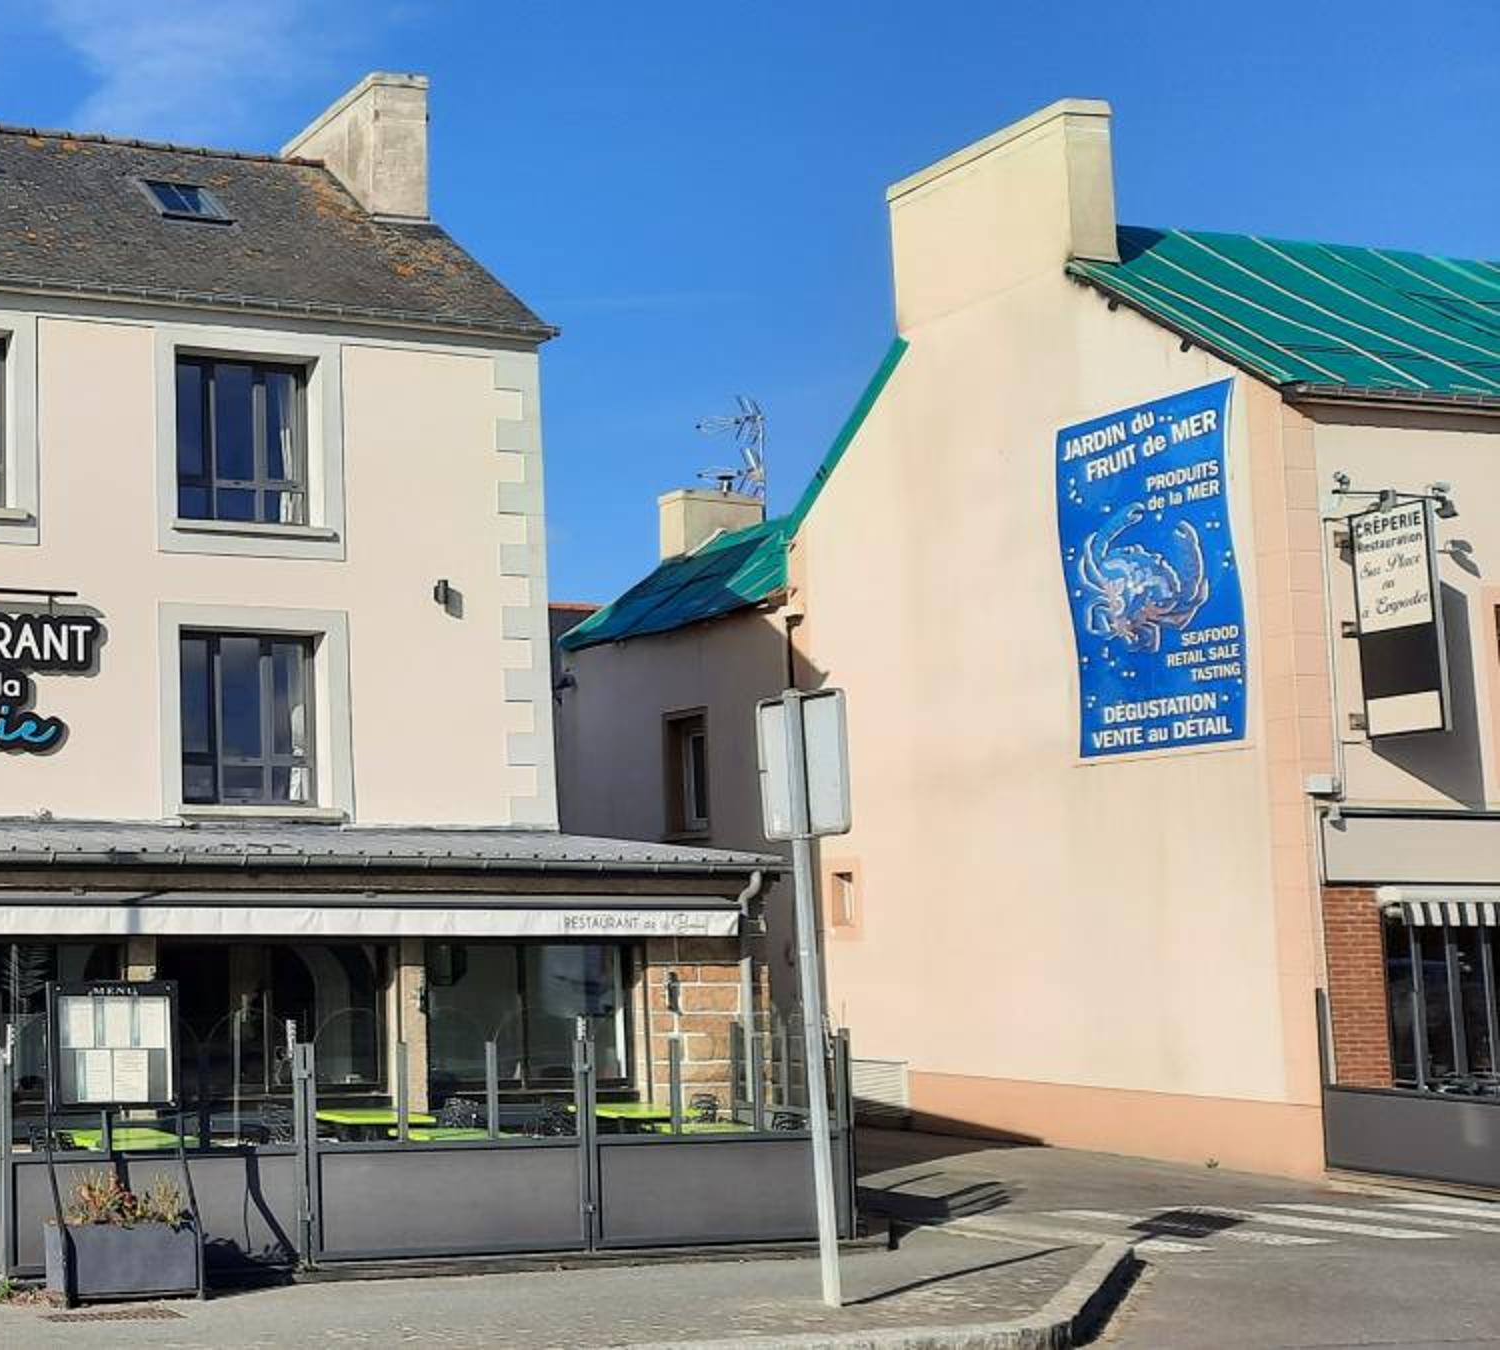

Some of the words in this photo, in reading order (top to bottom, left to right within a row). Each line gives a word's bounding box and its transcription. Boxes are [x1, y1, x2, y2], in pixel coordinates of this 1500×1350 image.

[1063, 421, 1127, 461] JARDIN
[1131, 411, 1155, 434] du
[1086, 444, 1136, 482] FRUIT
[1143, 435, 1167, 457] de
[1171, 409, 1218, 444] MER
[1146, 460, 1219, 492] PRODUITS
[1148, 495, 1165, 511] de
[1169, 490, 1183, 505] la
[1187, 479, 1220, 501] MER
[1355, 511, 1421, 538] CRÊPERIE
[1357, 532, 1422, 552] Restauration
[1181, 625, 1239, 646] SEAFOOD
[1167, 650, 1206, 667] RETAIL
[1209, 644, 1240, 661] SALE
[1191, 663, 1241, 682] TASTING
[1104, 692, 1217, 724] DÉGUSTATION
[1092, 727, 1144, 749] VENTE
[1148, 727, 1168, 742] au
[1173, 715, 1233, 739] DÉTAIL
[563, 914, 640, 930] RESTAURANT
